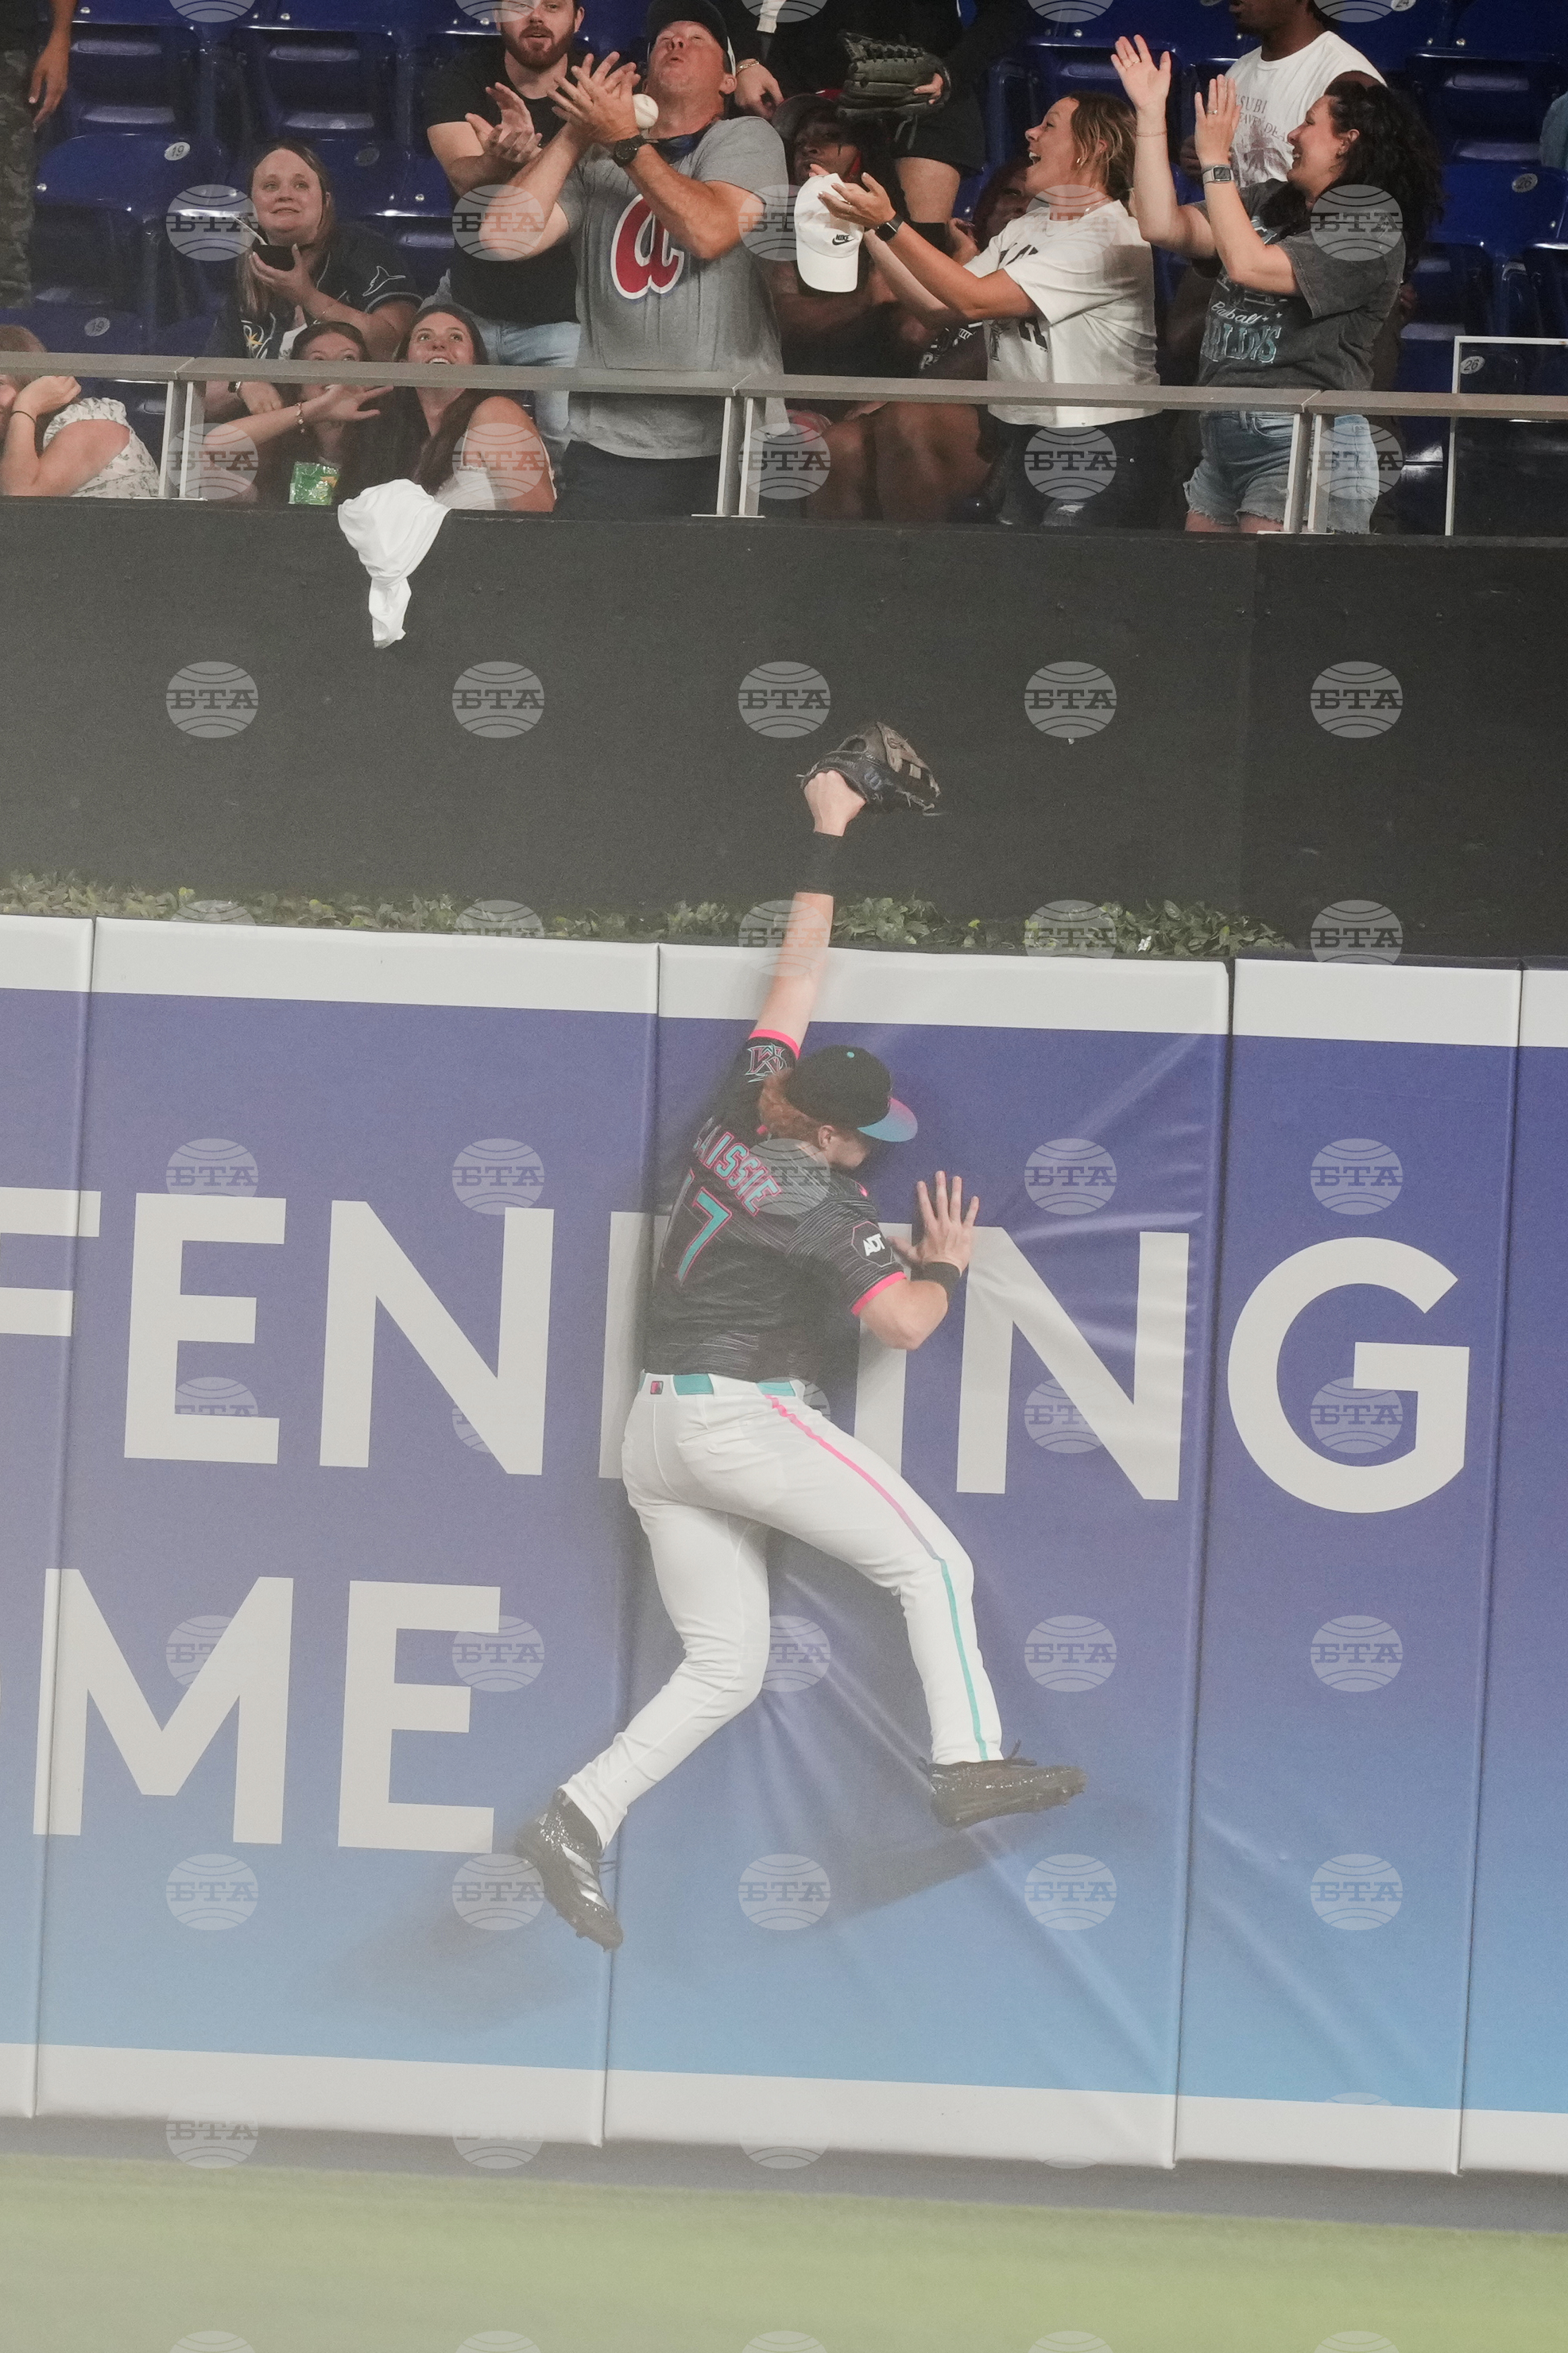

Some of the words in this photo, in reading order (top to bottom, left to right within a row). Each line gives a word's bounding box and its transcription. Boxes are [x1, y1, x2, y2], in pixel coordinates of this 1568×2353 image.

[172, 145, 184, 157] 19
[1463, 359, 1480, 370] 26
[863, 1233, 885, 1256] ADT
